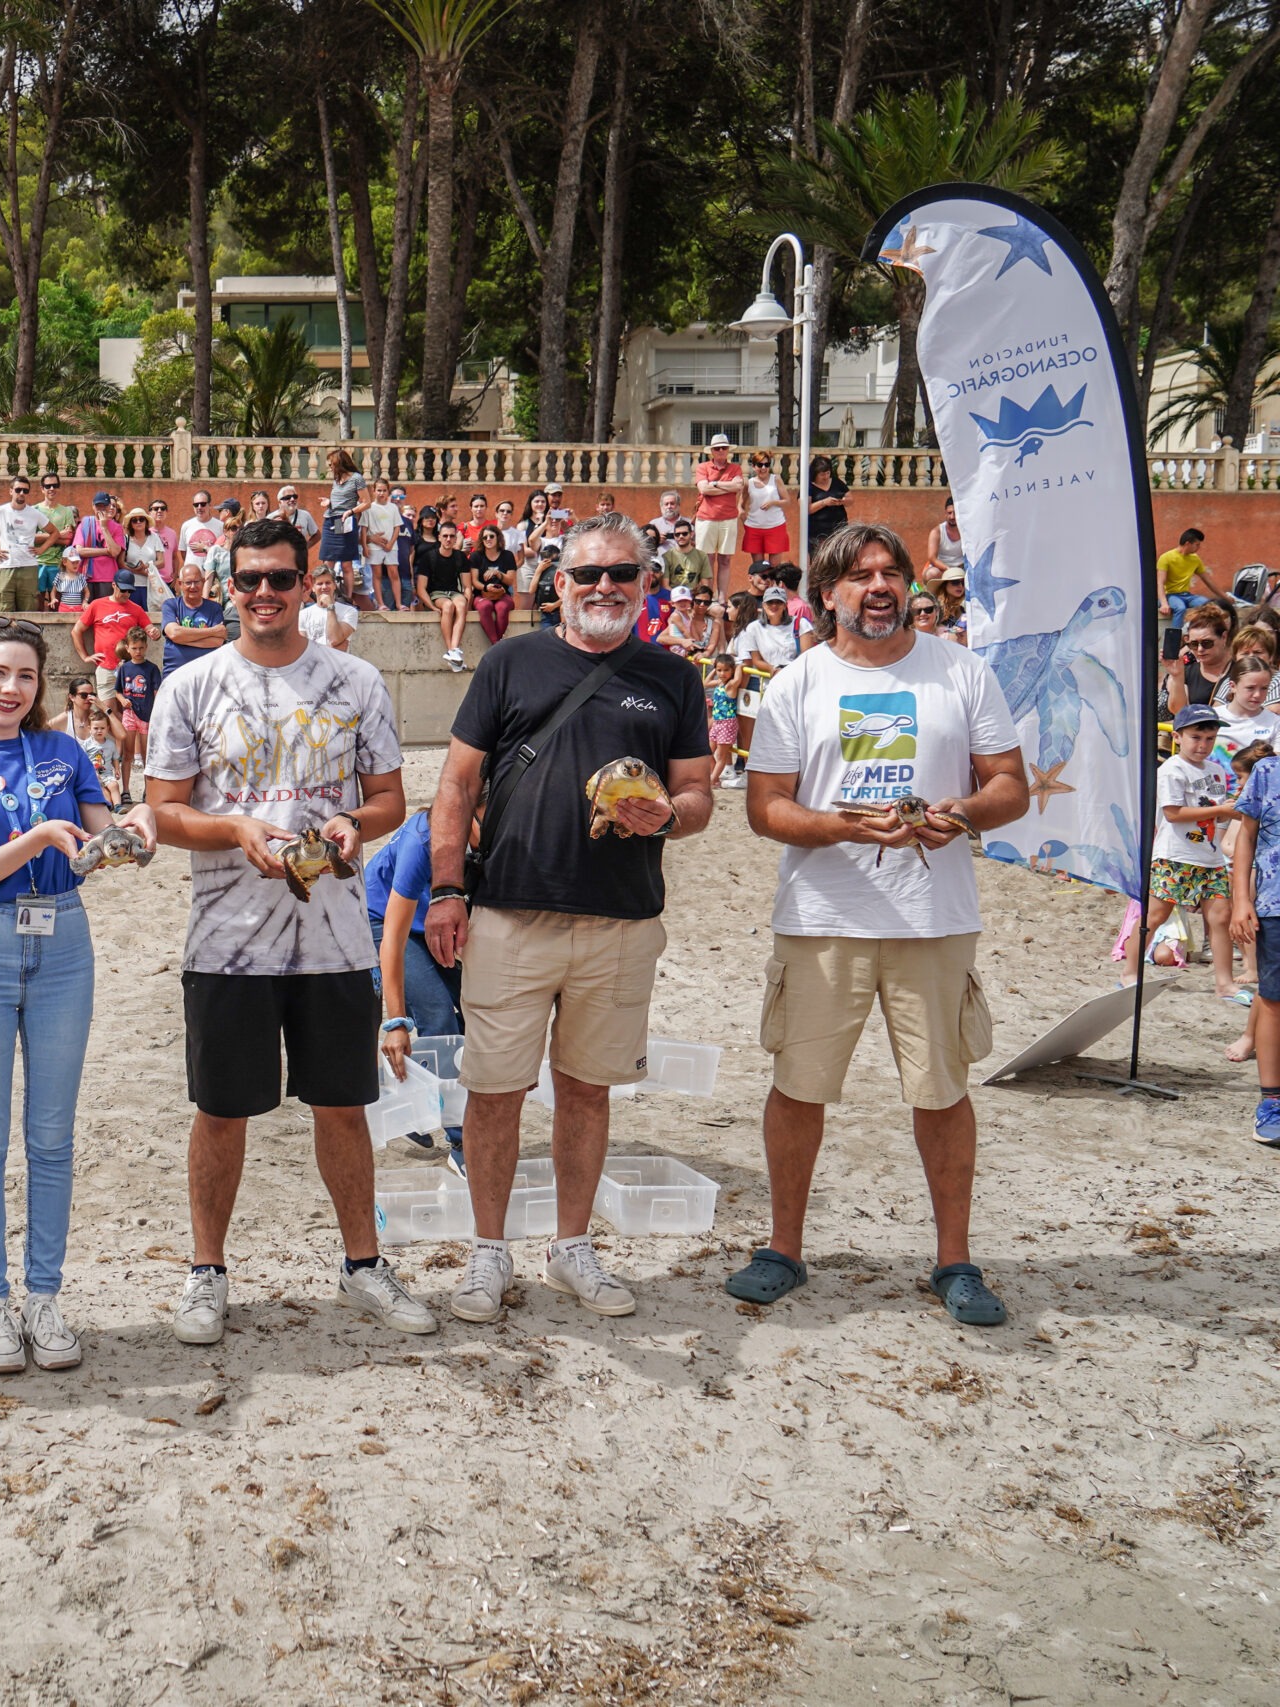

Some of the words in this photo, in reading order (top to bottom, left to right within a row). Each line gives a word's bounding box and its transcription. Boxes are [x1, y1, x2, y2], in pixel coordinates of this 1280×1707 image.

[841, 766, 864, 786] Life
[864, 764, 914, 784] MED
[225, 786, 344, 804] MALDIVES
[840, 785, 913, 800] TURTLES
